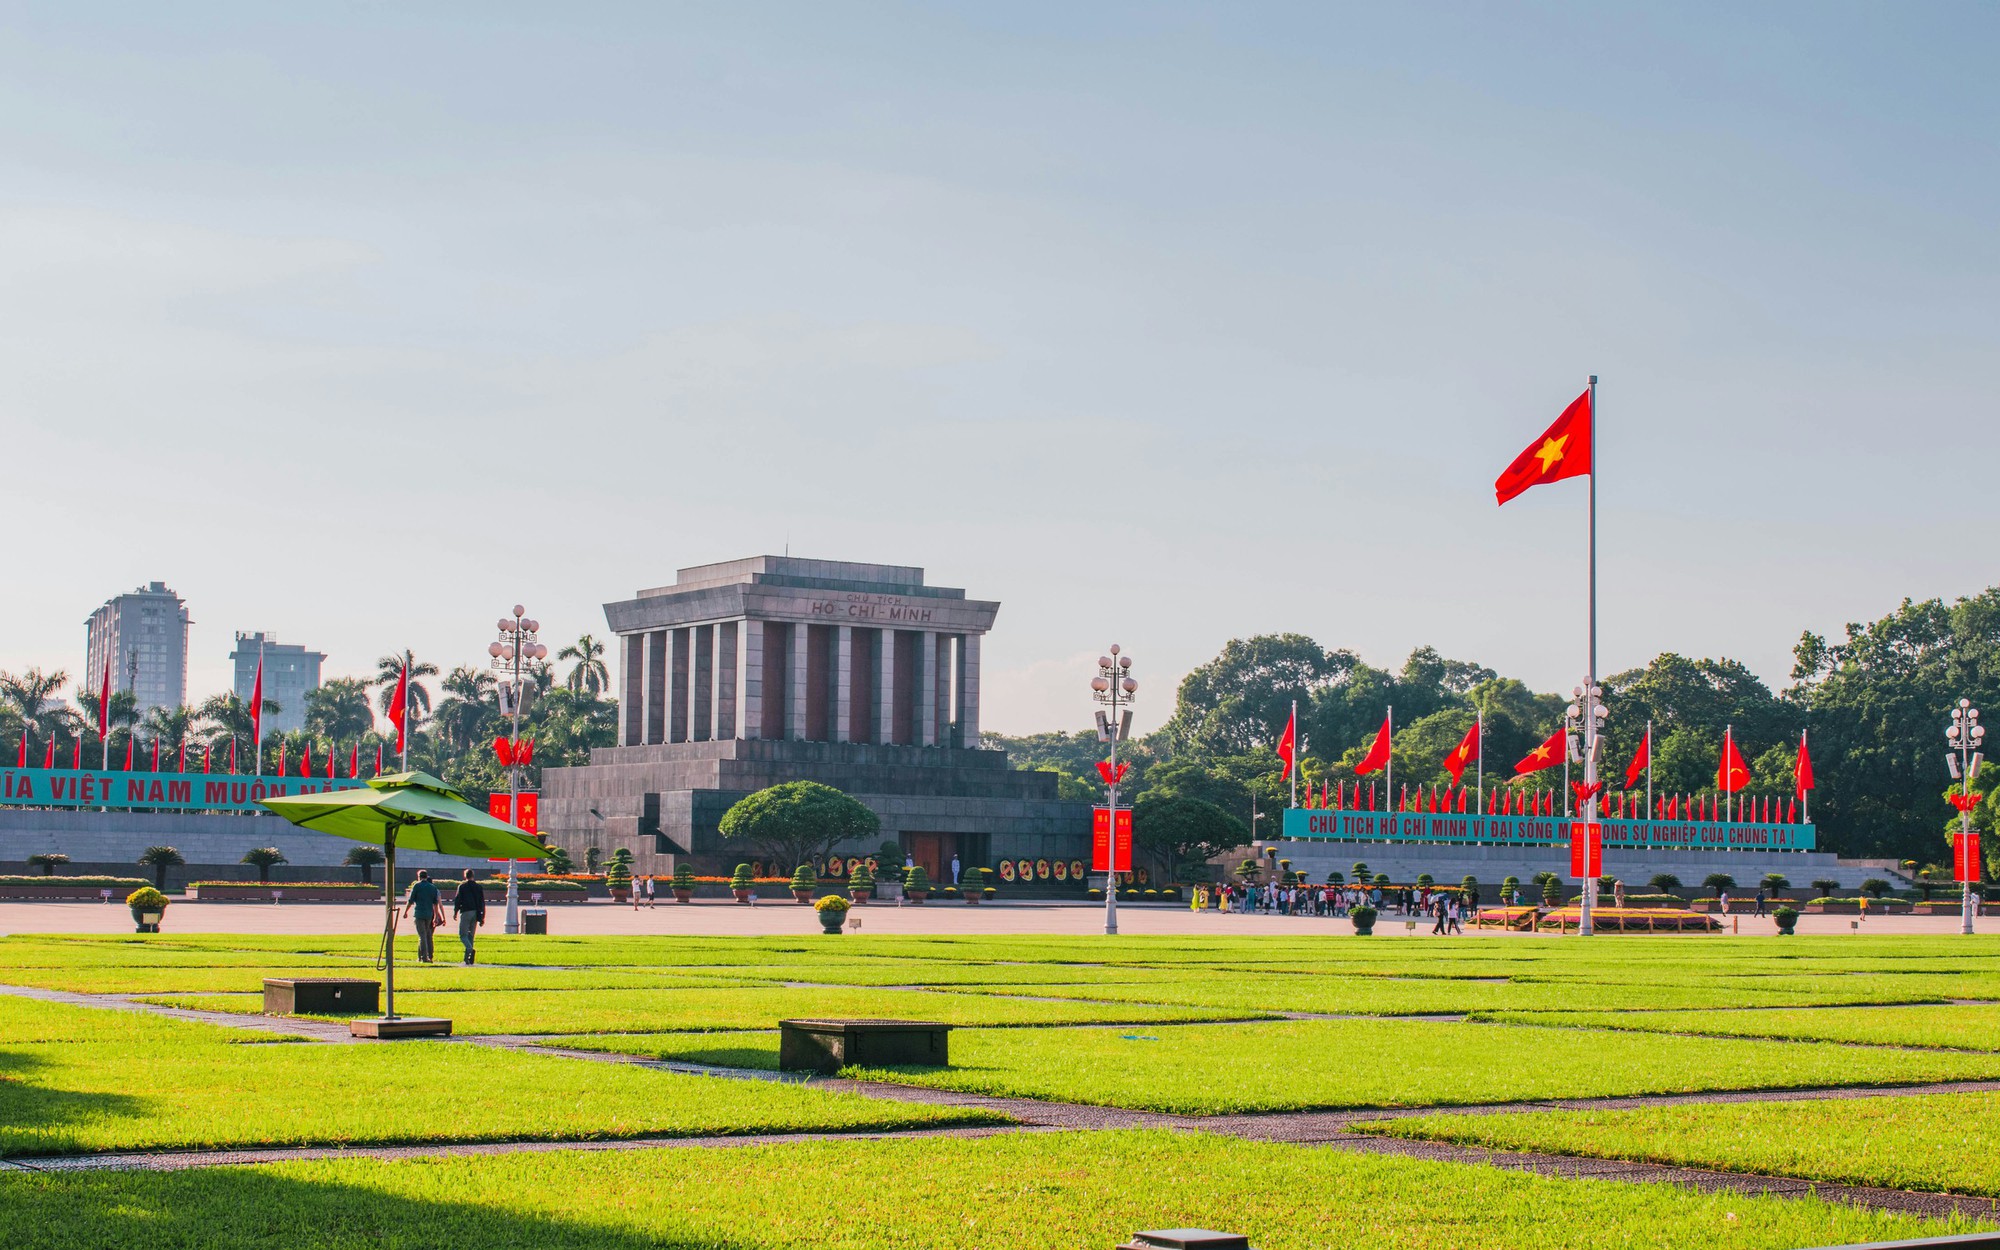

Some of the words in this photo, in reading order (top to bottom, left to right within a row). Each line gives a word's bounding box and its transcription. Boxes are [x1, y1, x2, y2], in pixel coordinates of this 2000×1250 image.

[0, 770, 34, 799] ĨA
[50, 773, 113, 804] VIỆT
[127, 779, 191, 803] NAM
[205, 778, 286, 804] MUÔN
[1309, 810, 1337, 833] CHỦ
[1343, 816, 1374, 837] TỊCH
[1404, 815, 1426, 836] CHÍ
[1432, 819, 1467, 837] MINH
[1473, 817, 1485, 837] VĨ
[1491, 821, 1512, 841] ĐẠI
[1518, 817, 1553, 839] SỐNG
[1633, 823, 1649, 844] SỰ
[1653, 823, 1697, 845] NGHIỆP
[1701, 822, 1724, 843] CỦA
[1729, 825, 1768, 844] CHÚNG
[1772, 829, 1786, 844] TA
